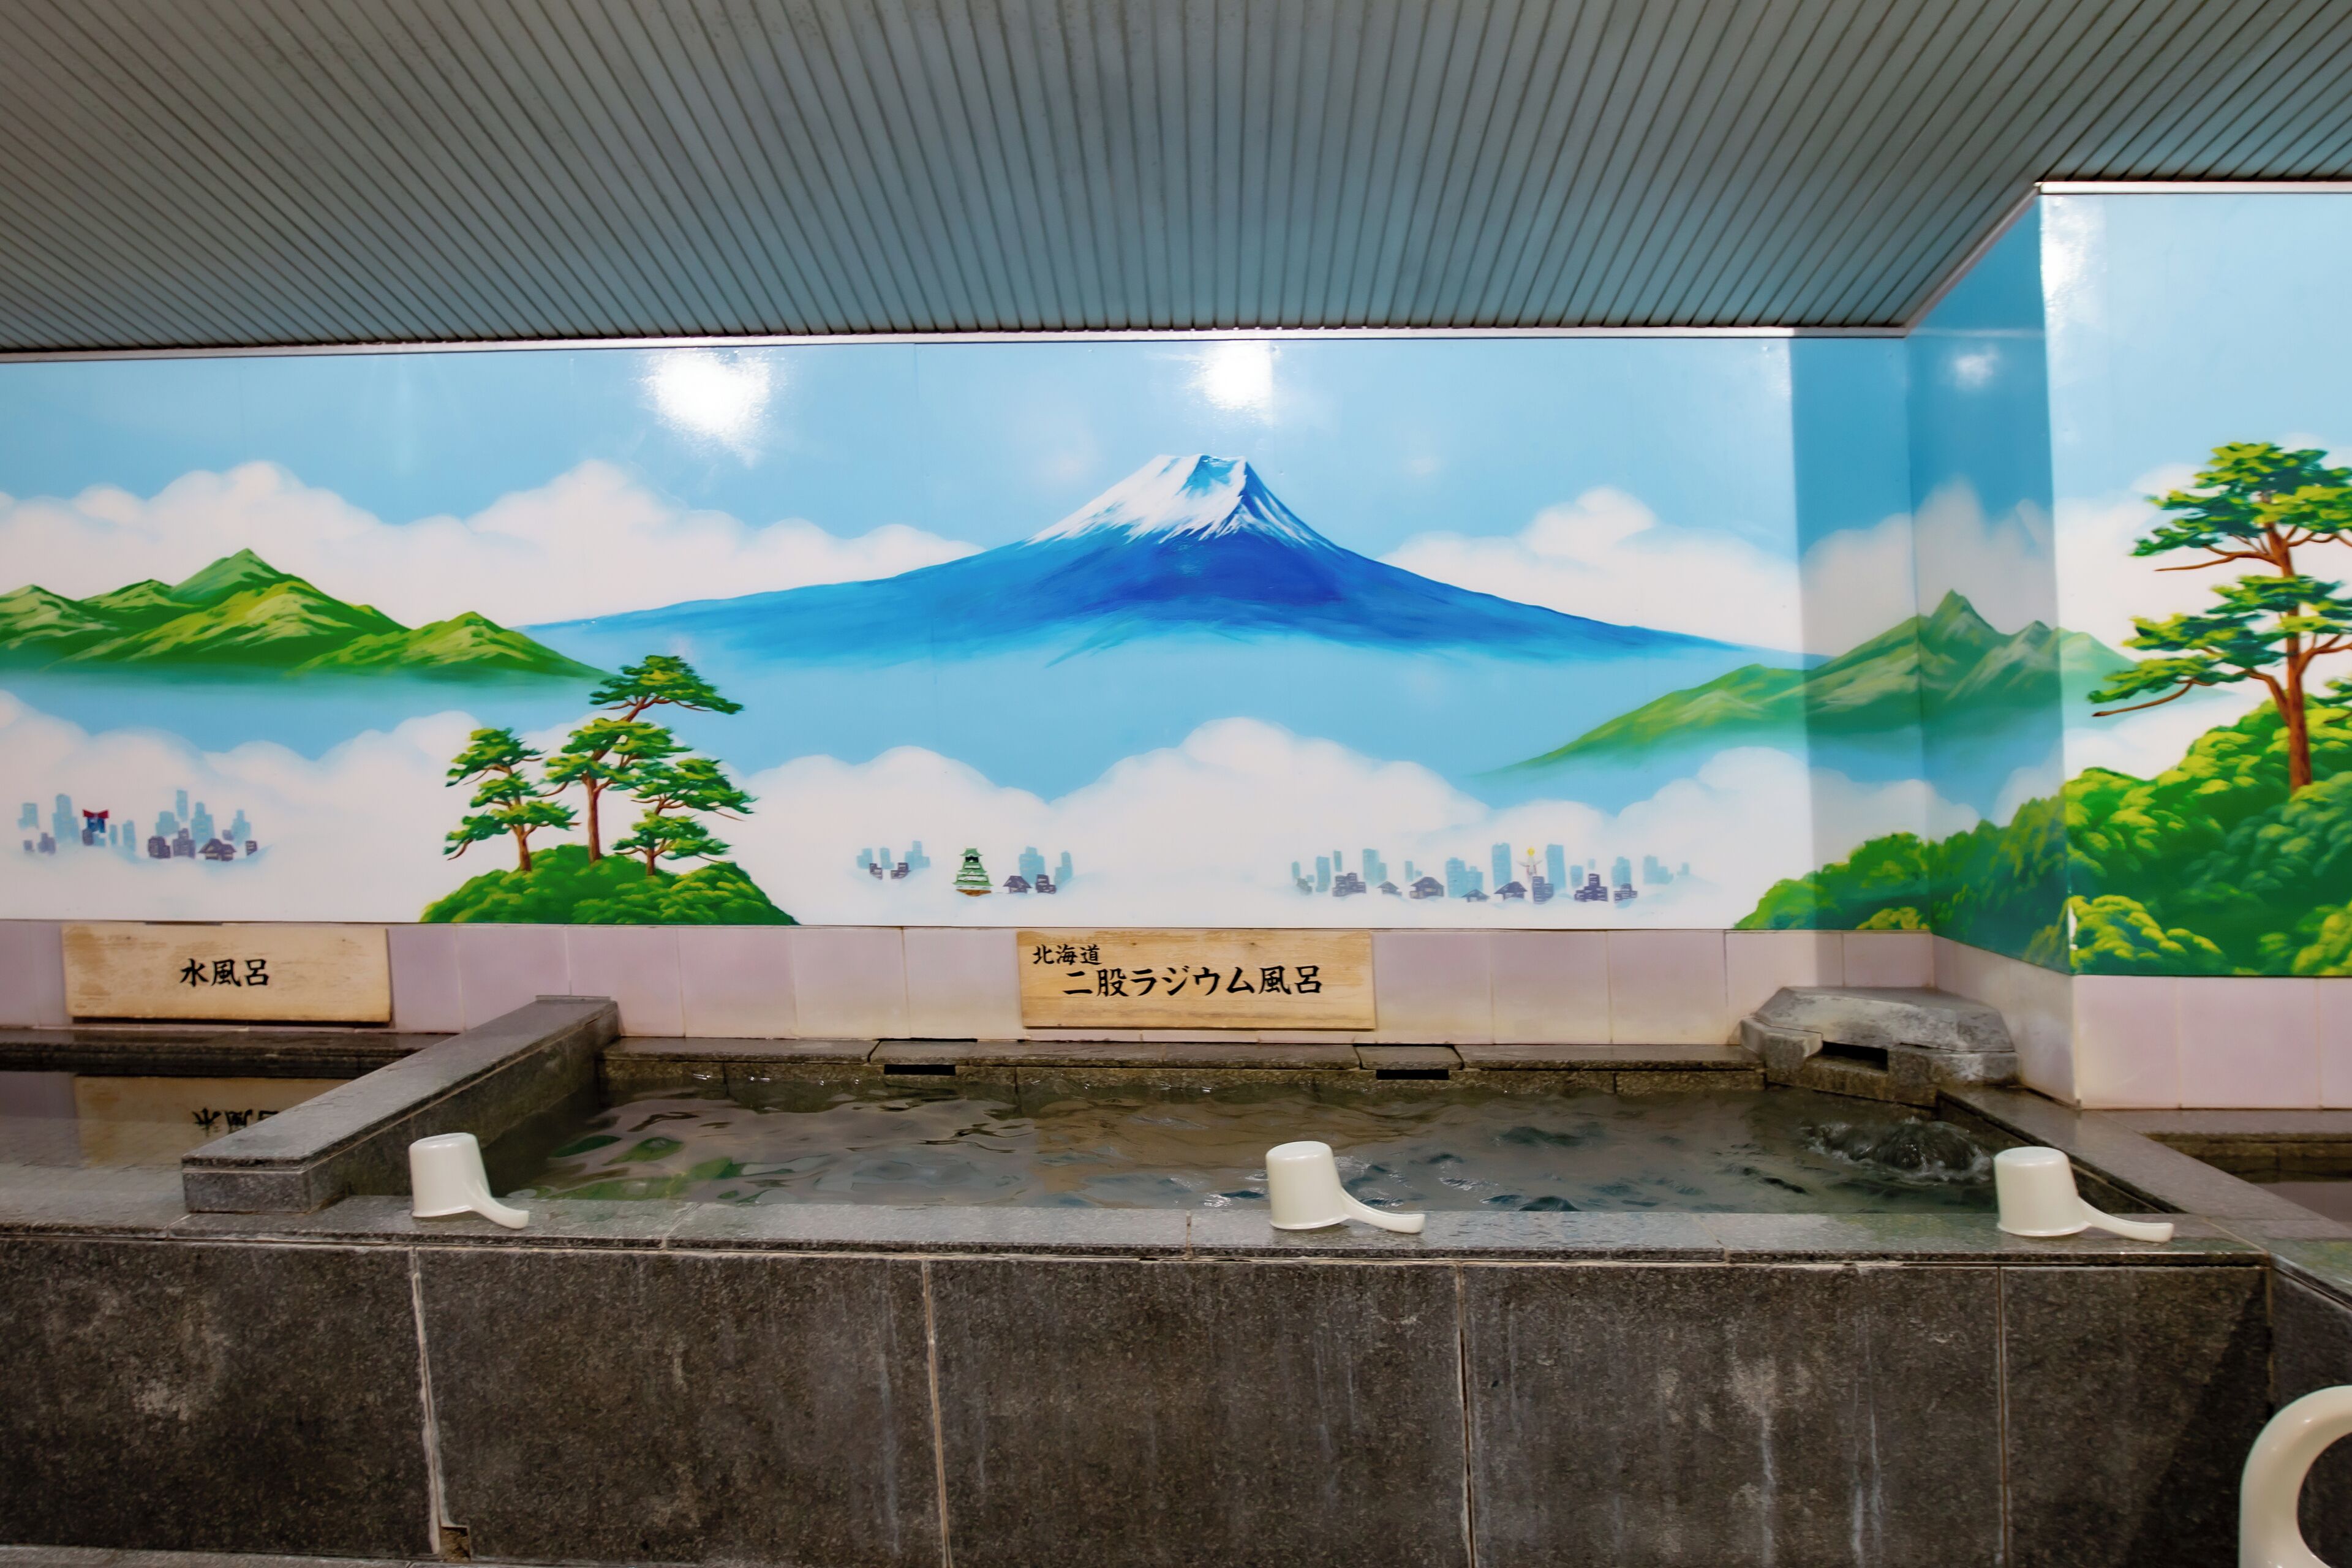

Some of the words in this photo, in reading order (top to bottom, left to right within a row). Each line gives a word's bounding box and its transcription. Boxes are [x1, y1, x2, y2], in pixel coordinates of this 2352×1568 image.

[1032, 943, 1102, 966] 北海道
[179, 958, 270, 987] 水風呂
[1062, 965, 1322, 997] 二股ラジウム風呂
